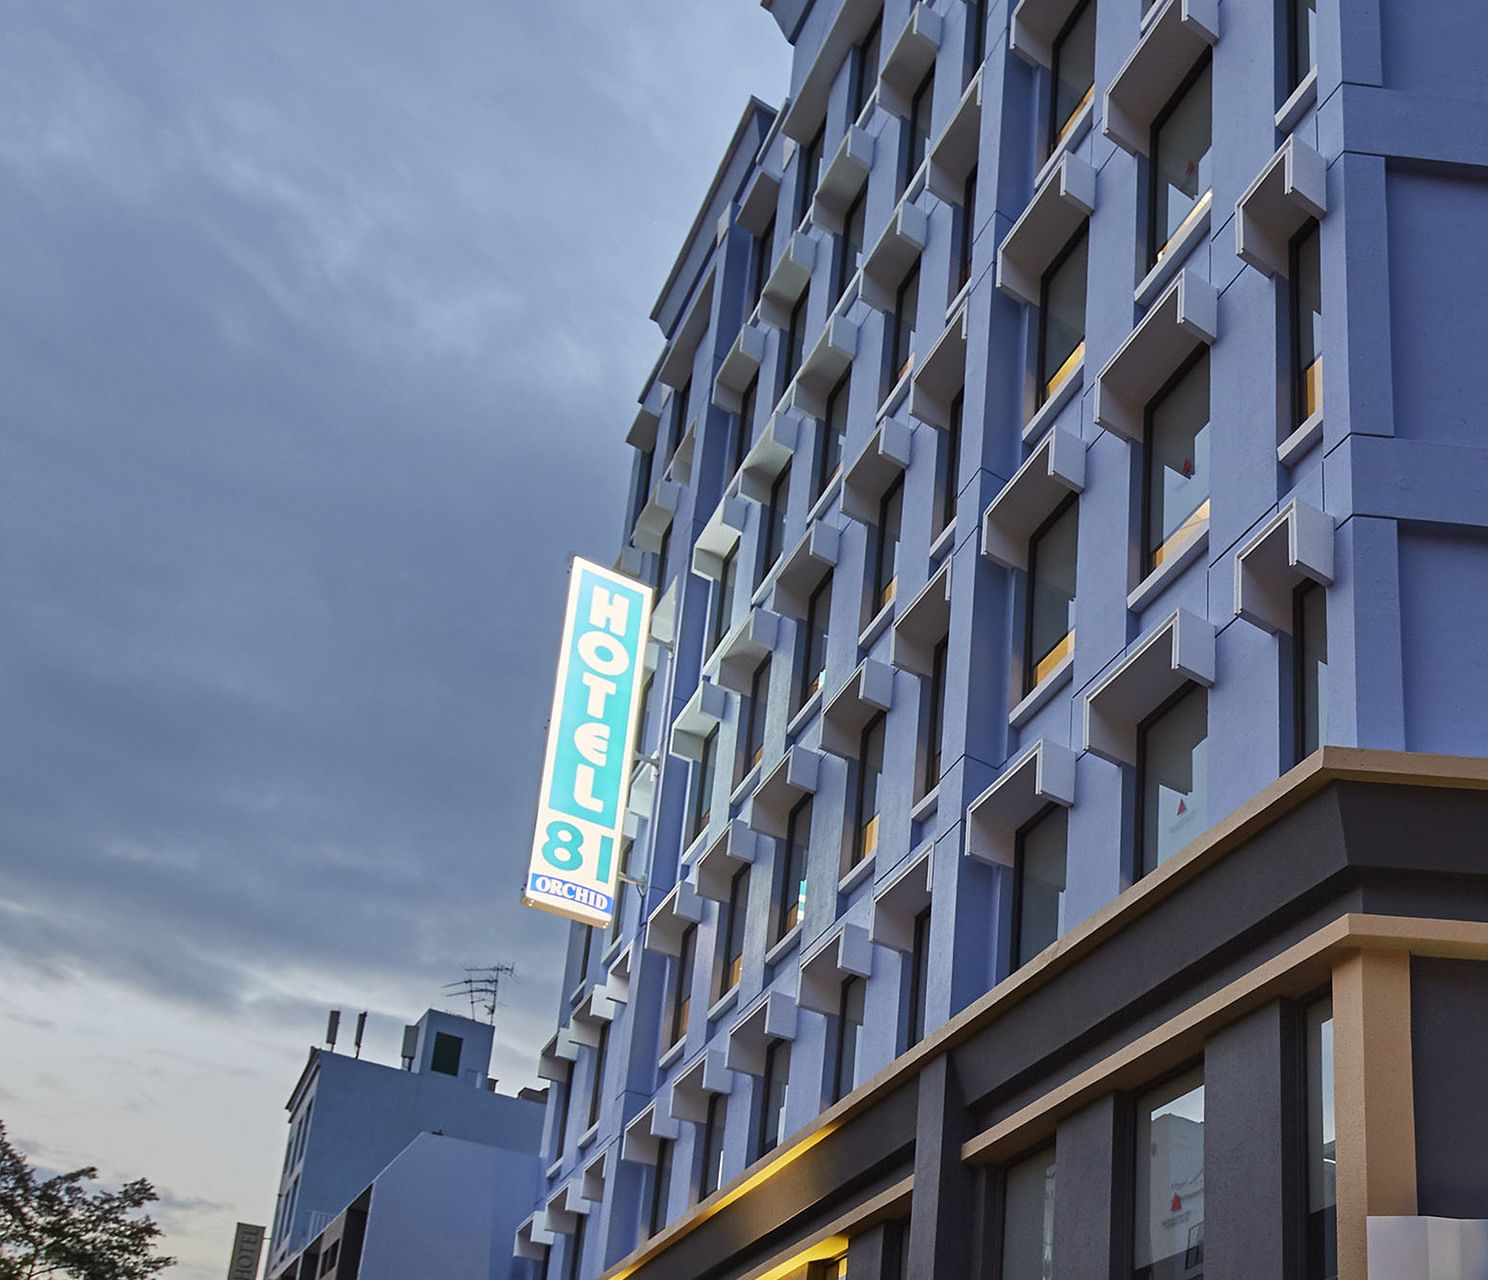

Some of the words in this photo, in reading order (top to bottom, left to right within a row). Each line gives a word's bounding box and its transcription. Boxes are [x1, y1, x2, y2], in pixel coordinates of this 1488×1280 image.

[573, 585, 630, 813] HOTEL
[541, 821, 614, 884] 81
[535, 876, 608, 910] ORCHID
